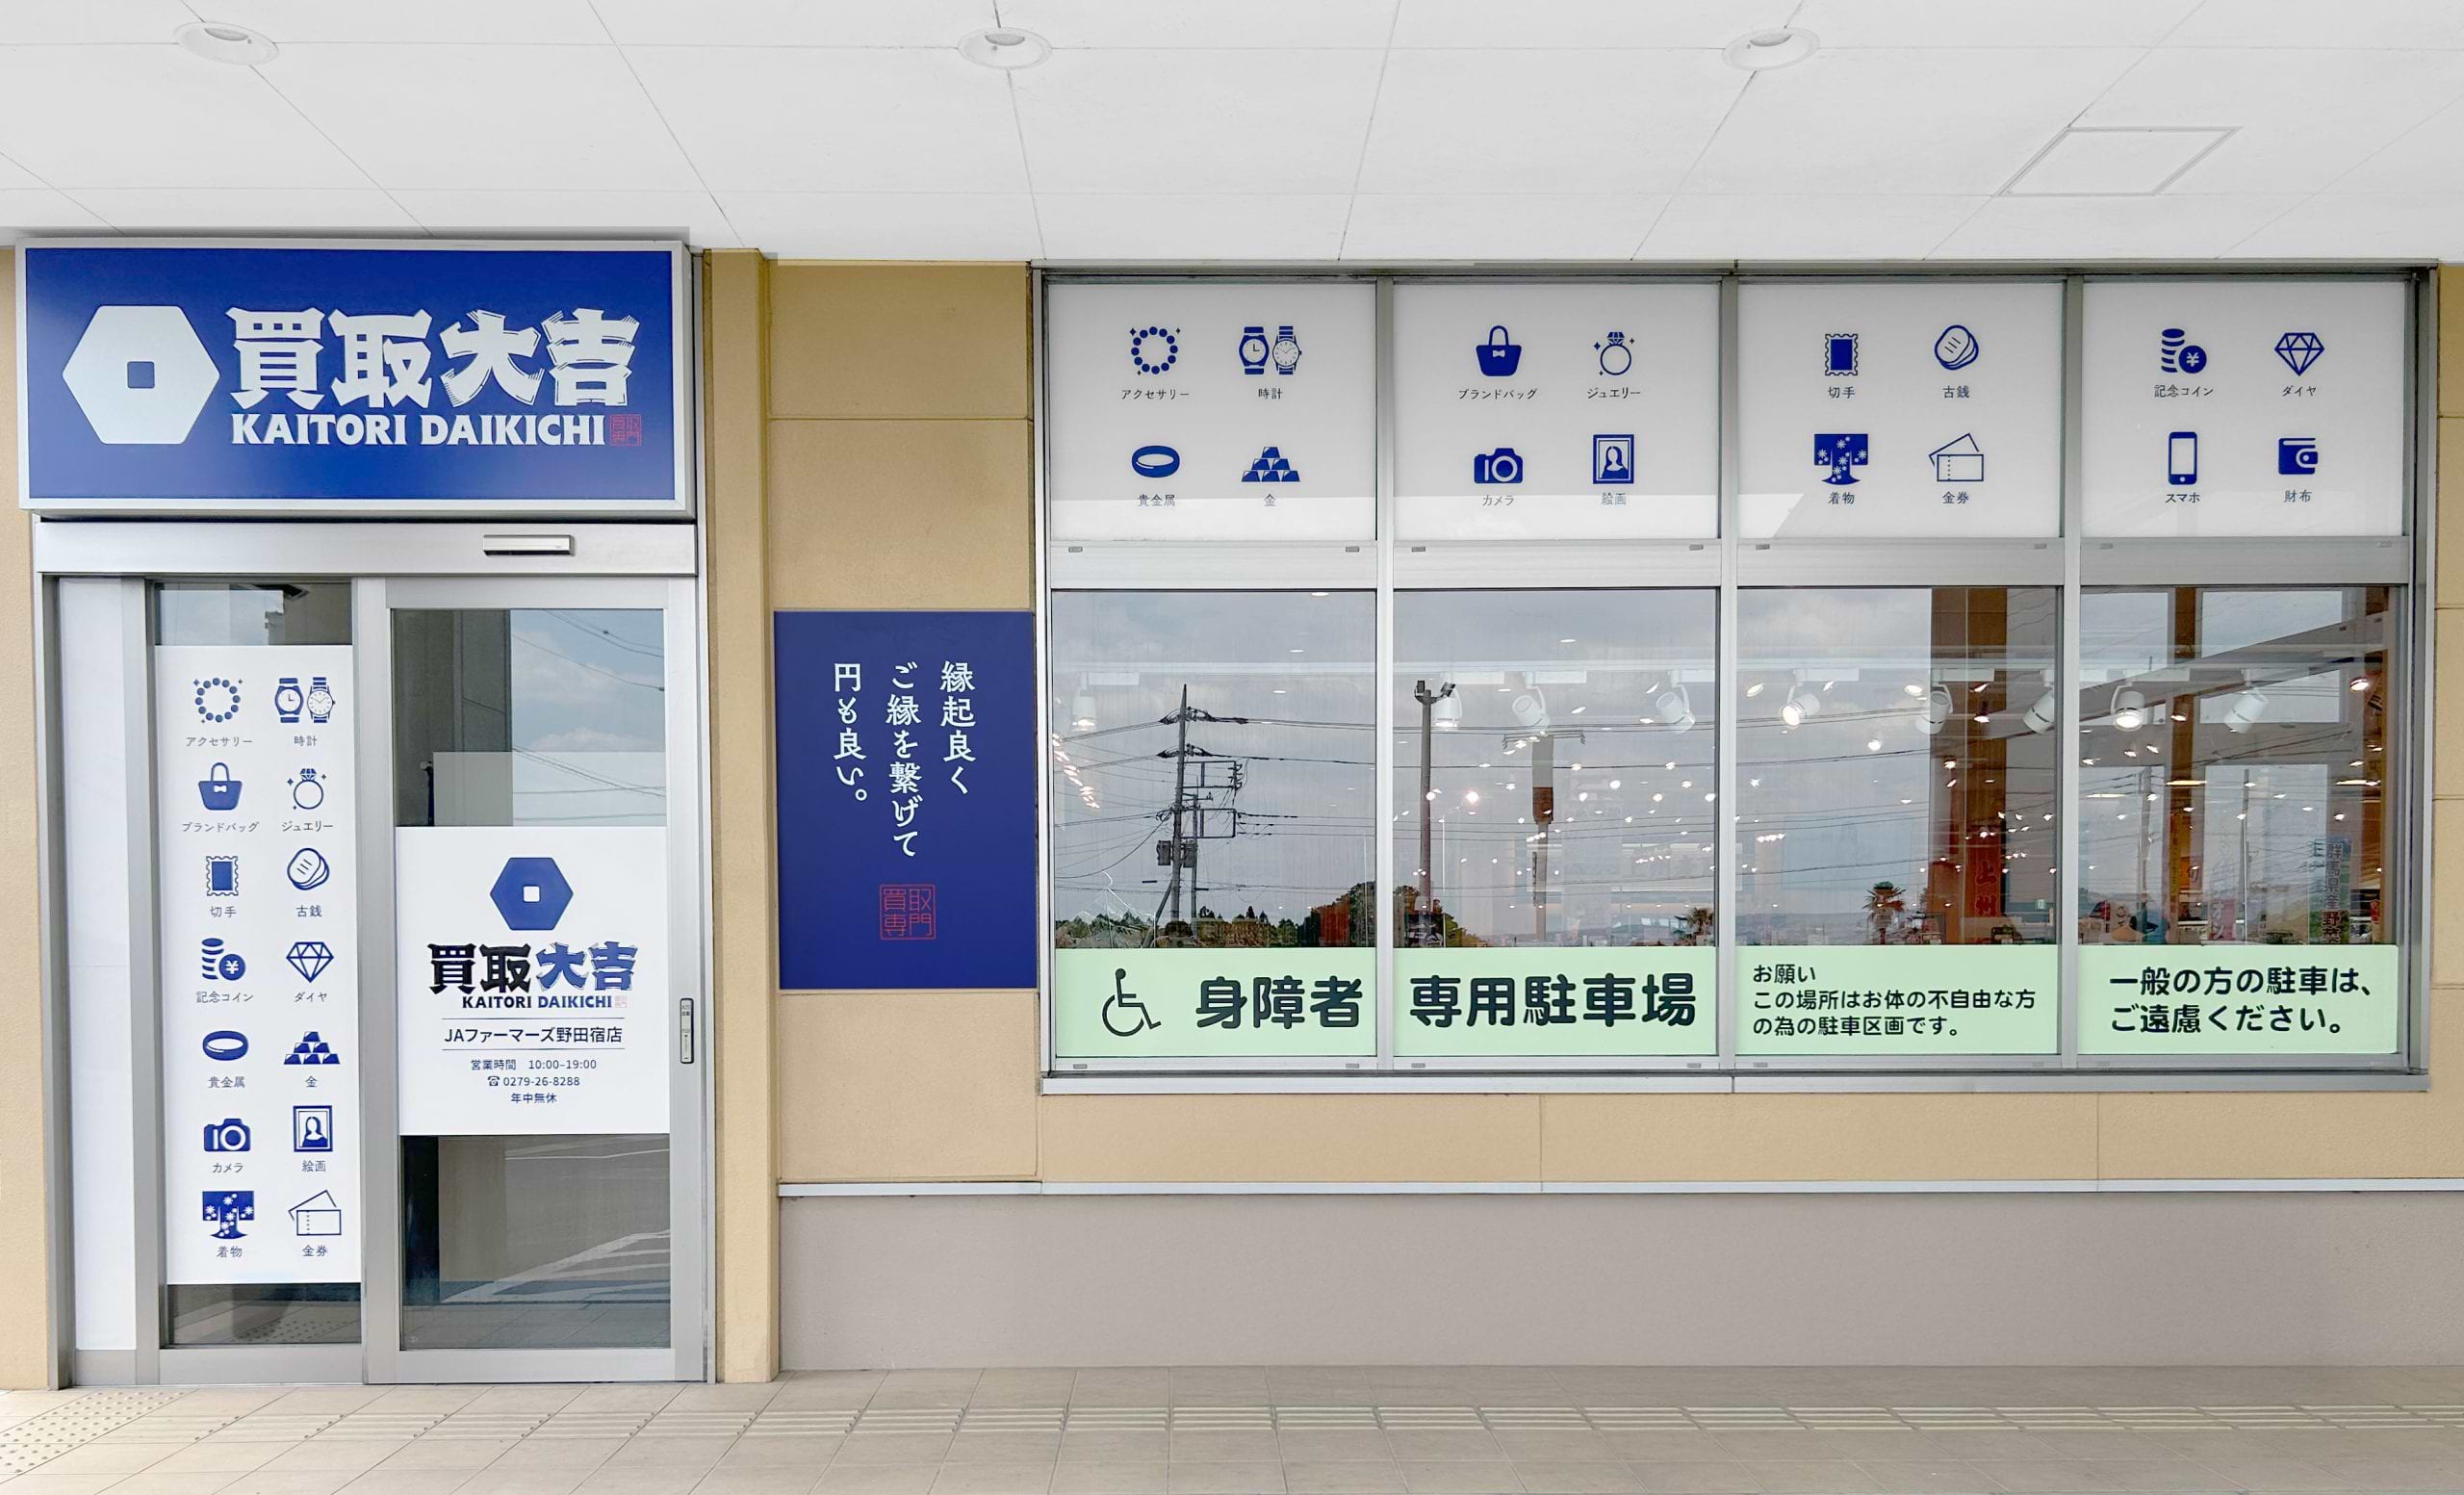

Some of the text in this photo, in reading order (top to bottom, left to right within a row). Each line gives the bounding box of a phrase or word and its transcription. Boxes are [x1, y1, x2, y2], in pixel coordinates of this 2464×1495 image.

[225, 306, 640, 411] 買取大吉
[1121, 388, 1190, 400] アクセサリー
[1258, 387, 1283, 400] 時計
[1458, 388, 1538, 400] ブランドバッグ
[1587, 386, 1641, 400] ジュエリー
[1827, 385, 1856, 400] 切手
[1942, 384, 1970, 399] 古銭
[2153, 383, 2214, 399] 記念コイン
[2282, 384, 2317, 398] ダイヤ
[230, 413, 606, 446] KAITORI DAIKICHI
[1137, 493, 1175, 507] 貴金属
[1263, 493, 1276, 507] 金
[1482, 492, 1517, 507] カメラ
[1601, 491, 1627, 505] 絵画
[1828, 491, 1856, 505] 着物
[1941, 490, 1970, 504] 金券
[2165, 492, 2200, 503] スマホ
[2283, 489, 2313, 503] 財布
[833, 662, 868, 802] 円も良い。
[939, 660, 977, 794] 縁起良く
[186, 736, 253, 748] アクセサリー
[294, 735, 318, 747] 時計
[885, 660, 924, 857] ご縁を繋げて
[182, 821, 260, 833] ブランドバッグ
[281, 820, 334, 833] ジュエリー
[883, 888, 932, 912] 買取
[209, 905, 237, 918] 切手
[295, 904, 322, 917] 古銭
[884, 913, 933, 938] 専門
[427, 941, 638, 994] 買取大吉
[1753, 964, 1816, 985] お願い
[2109, 965, 2371, 996] 一般の方の駐車は、
[195, 990, 254, 1004] 記念コイン
[294, 991, 327, 1003] ダイヤ
[462, 995, 532, 1009] KAITORI
[537, 995, 612, 1009] DAIKICHI
[1194, 972, 1697, 1030] 身障者 専用駐車場
[1754, 988, 2036, 1011] この場所はお体の不自由な方
[2111, 1002, 2341, 1034] ご遠慮ください。
[1753, 1015, 1958, 1037] の為の駐車区画です。
[444, 1026, 623, 1044] JAファーマーズ野田宿店
[470, 1059, 517, 1071] 営業時間
[207, 1075, 245, 1089] 貴金属
[304, 1075, 319, 1088] 金
[502, 1076, 580, 1087] 0279-26-8288
[510, 1093, 557, 1104] 年中無休
[212, 1162, 244, 1173] カメラ
[301, 1159, 326, 1173] 絵画
[216, 1245, 243, 1258] 着物
[301, 1244, 329, 1257] 金券
